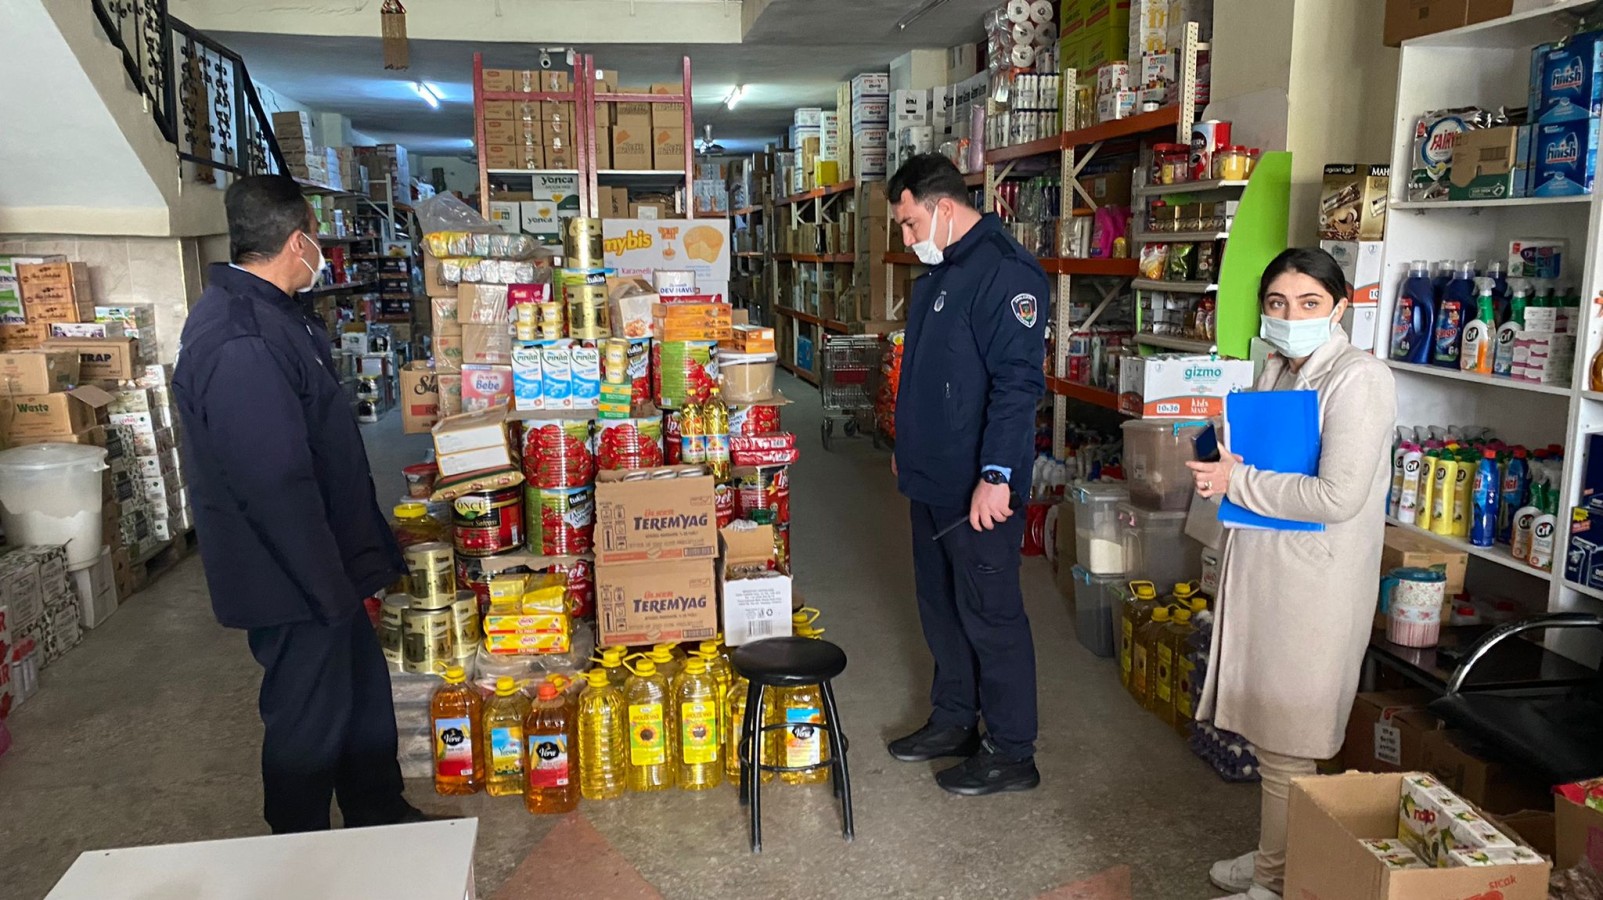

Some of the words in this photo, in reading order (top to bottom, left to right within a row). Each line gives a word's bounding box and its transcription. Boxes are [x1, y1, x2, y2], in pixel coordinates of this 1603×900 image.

[541, 176, 574, 185] yonca
[527, 217, 552, 225] yonca
[80, 353, 112, 362] TRAP
[1184, 366, 1222, 380] gizmo
[476, 380, 500, 391] Bebe
